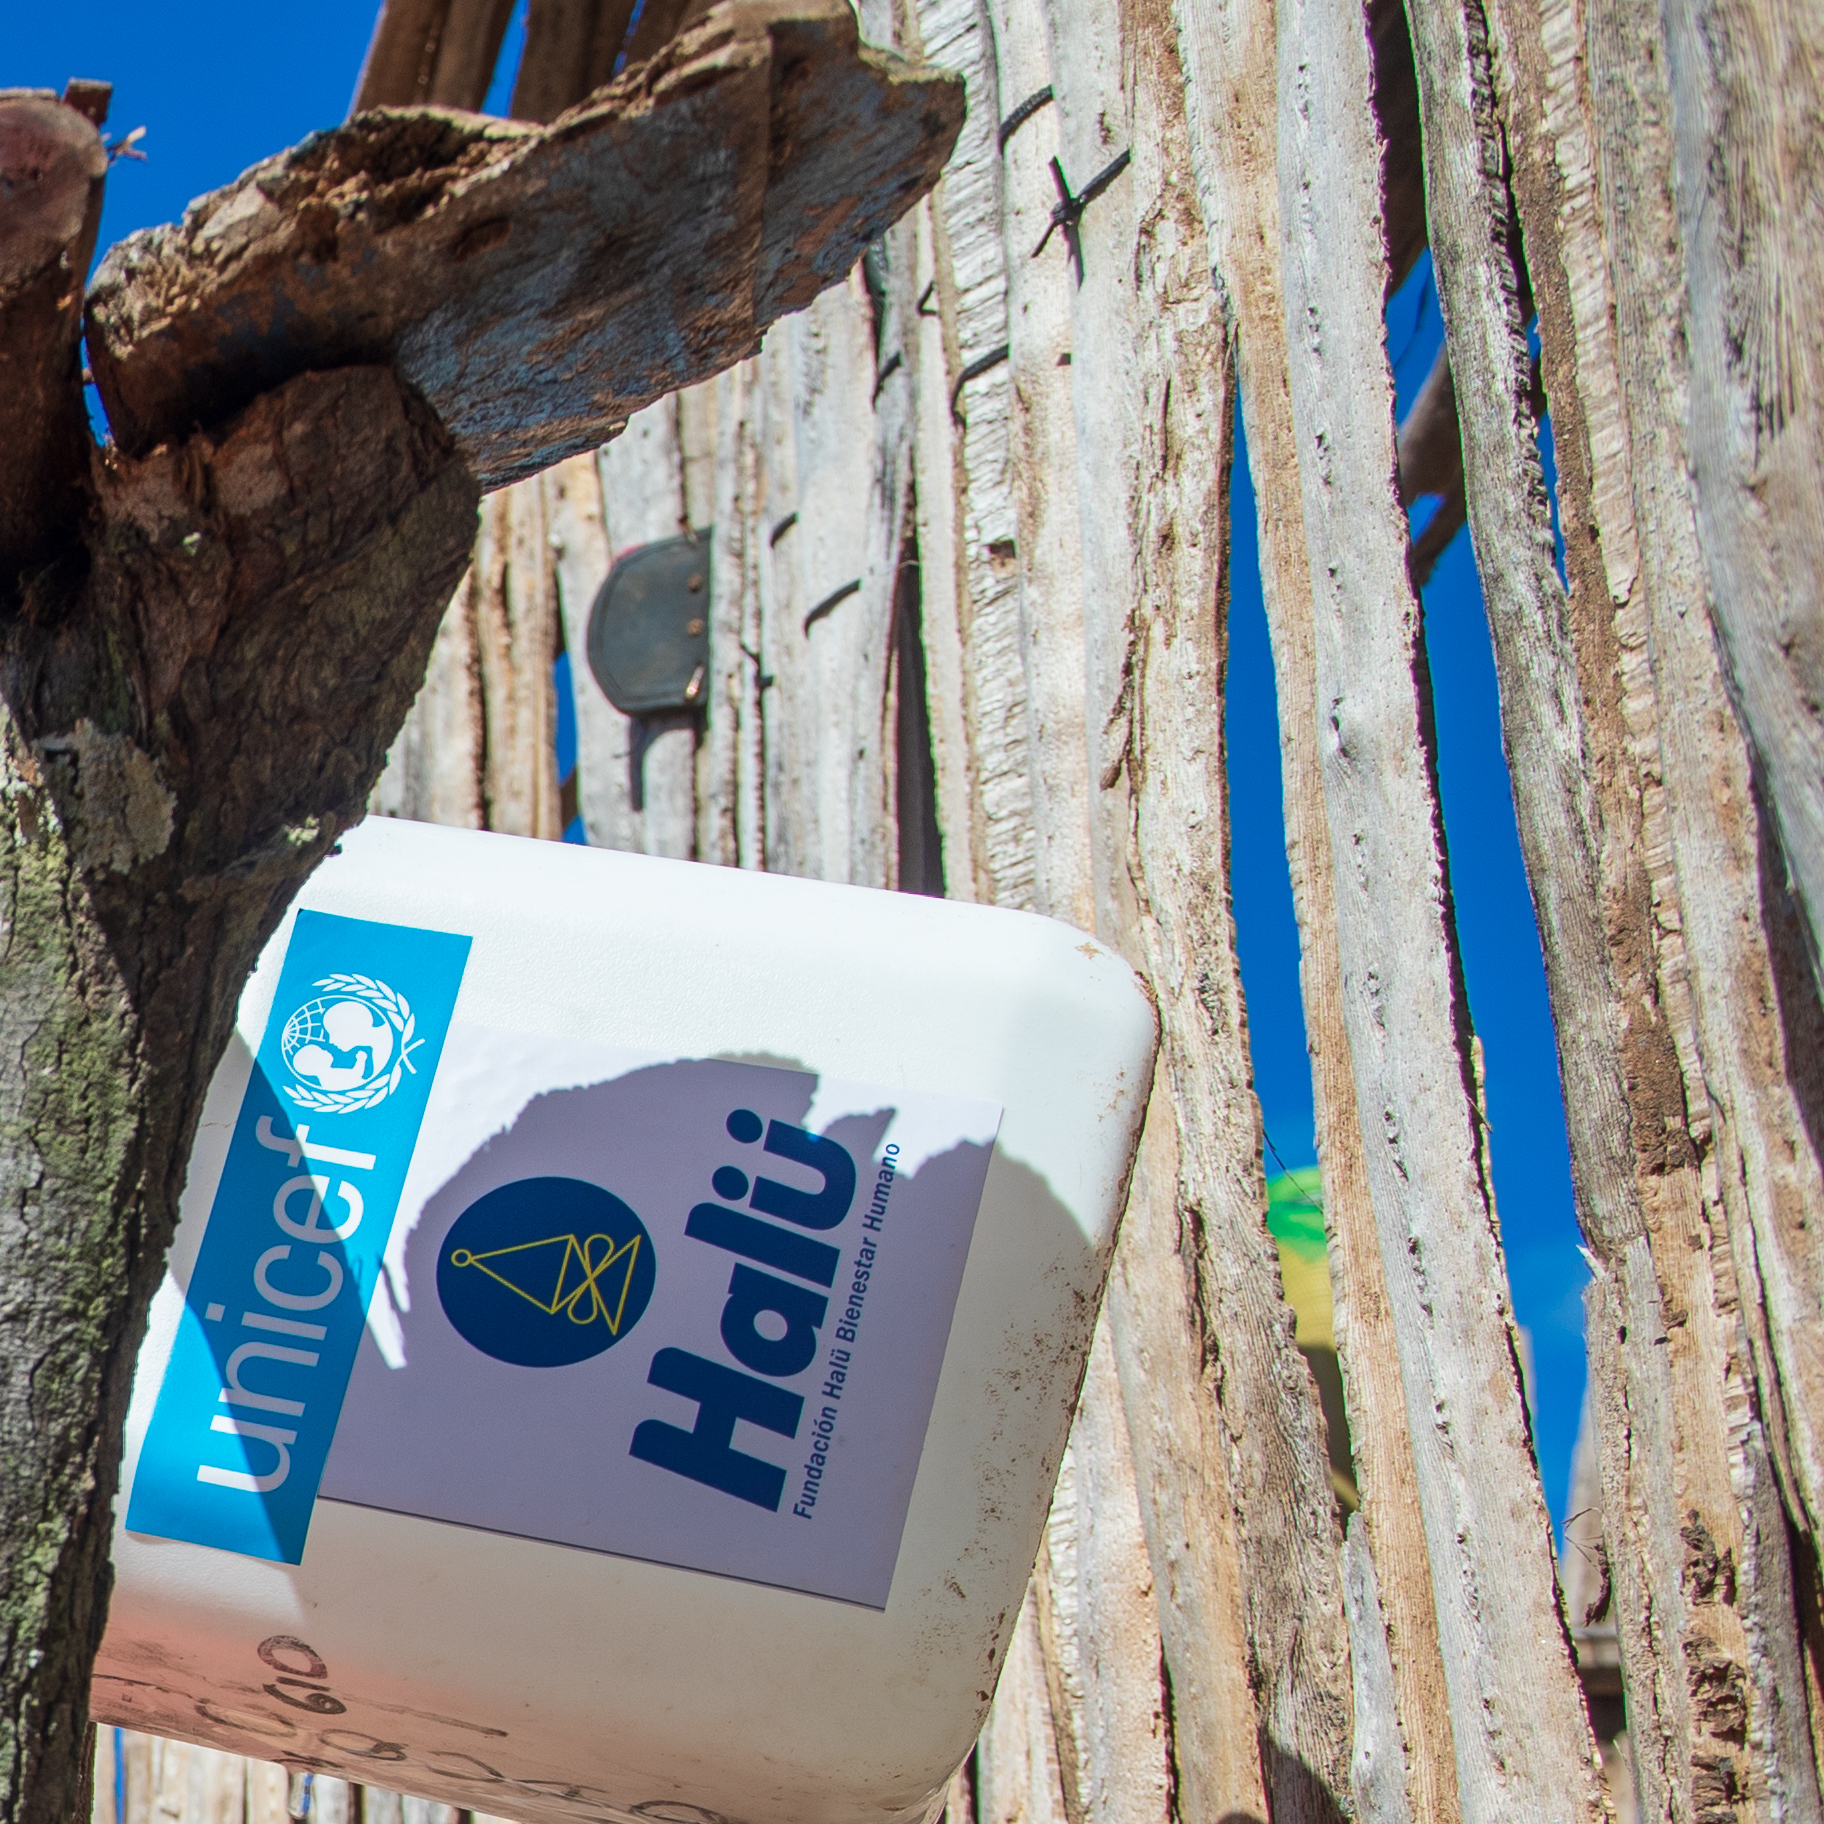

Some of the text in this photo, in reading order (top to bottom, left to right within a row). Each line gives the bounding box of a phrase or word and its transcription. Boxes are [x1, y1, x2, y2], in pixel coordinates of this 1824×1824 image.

[197, 1115, 378, 1493] unicef
[628, 1109, 857, 1512] Halü
[793, 1143, 900, 1519] Fundación Halü Bienestar Humano
